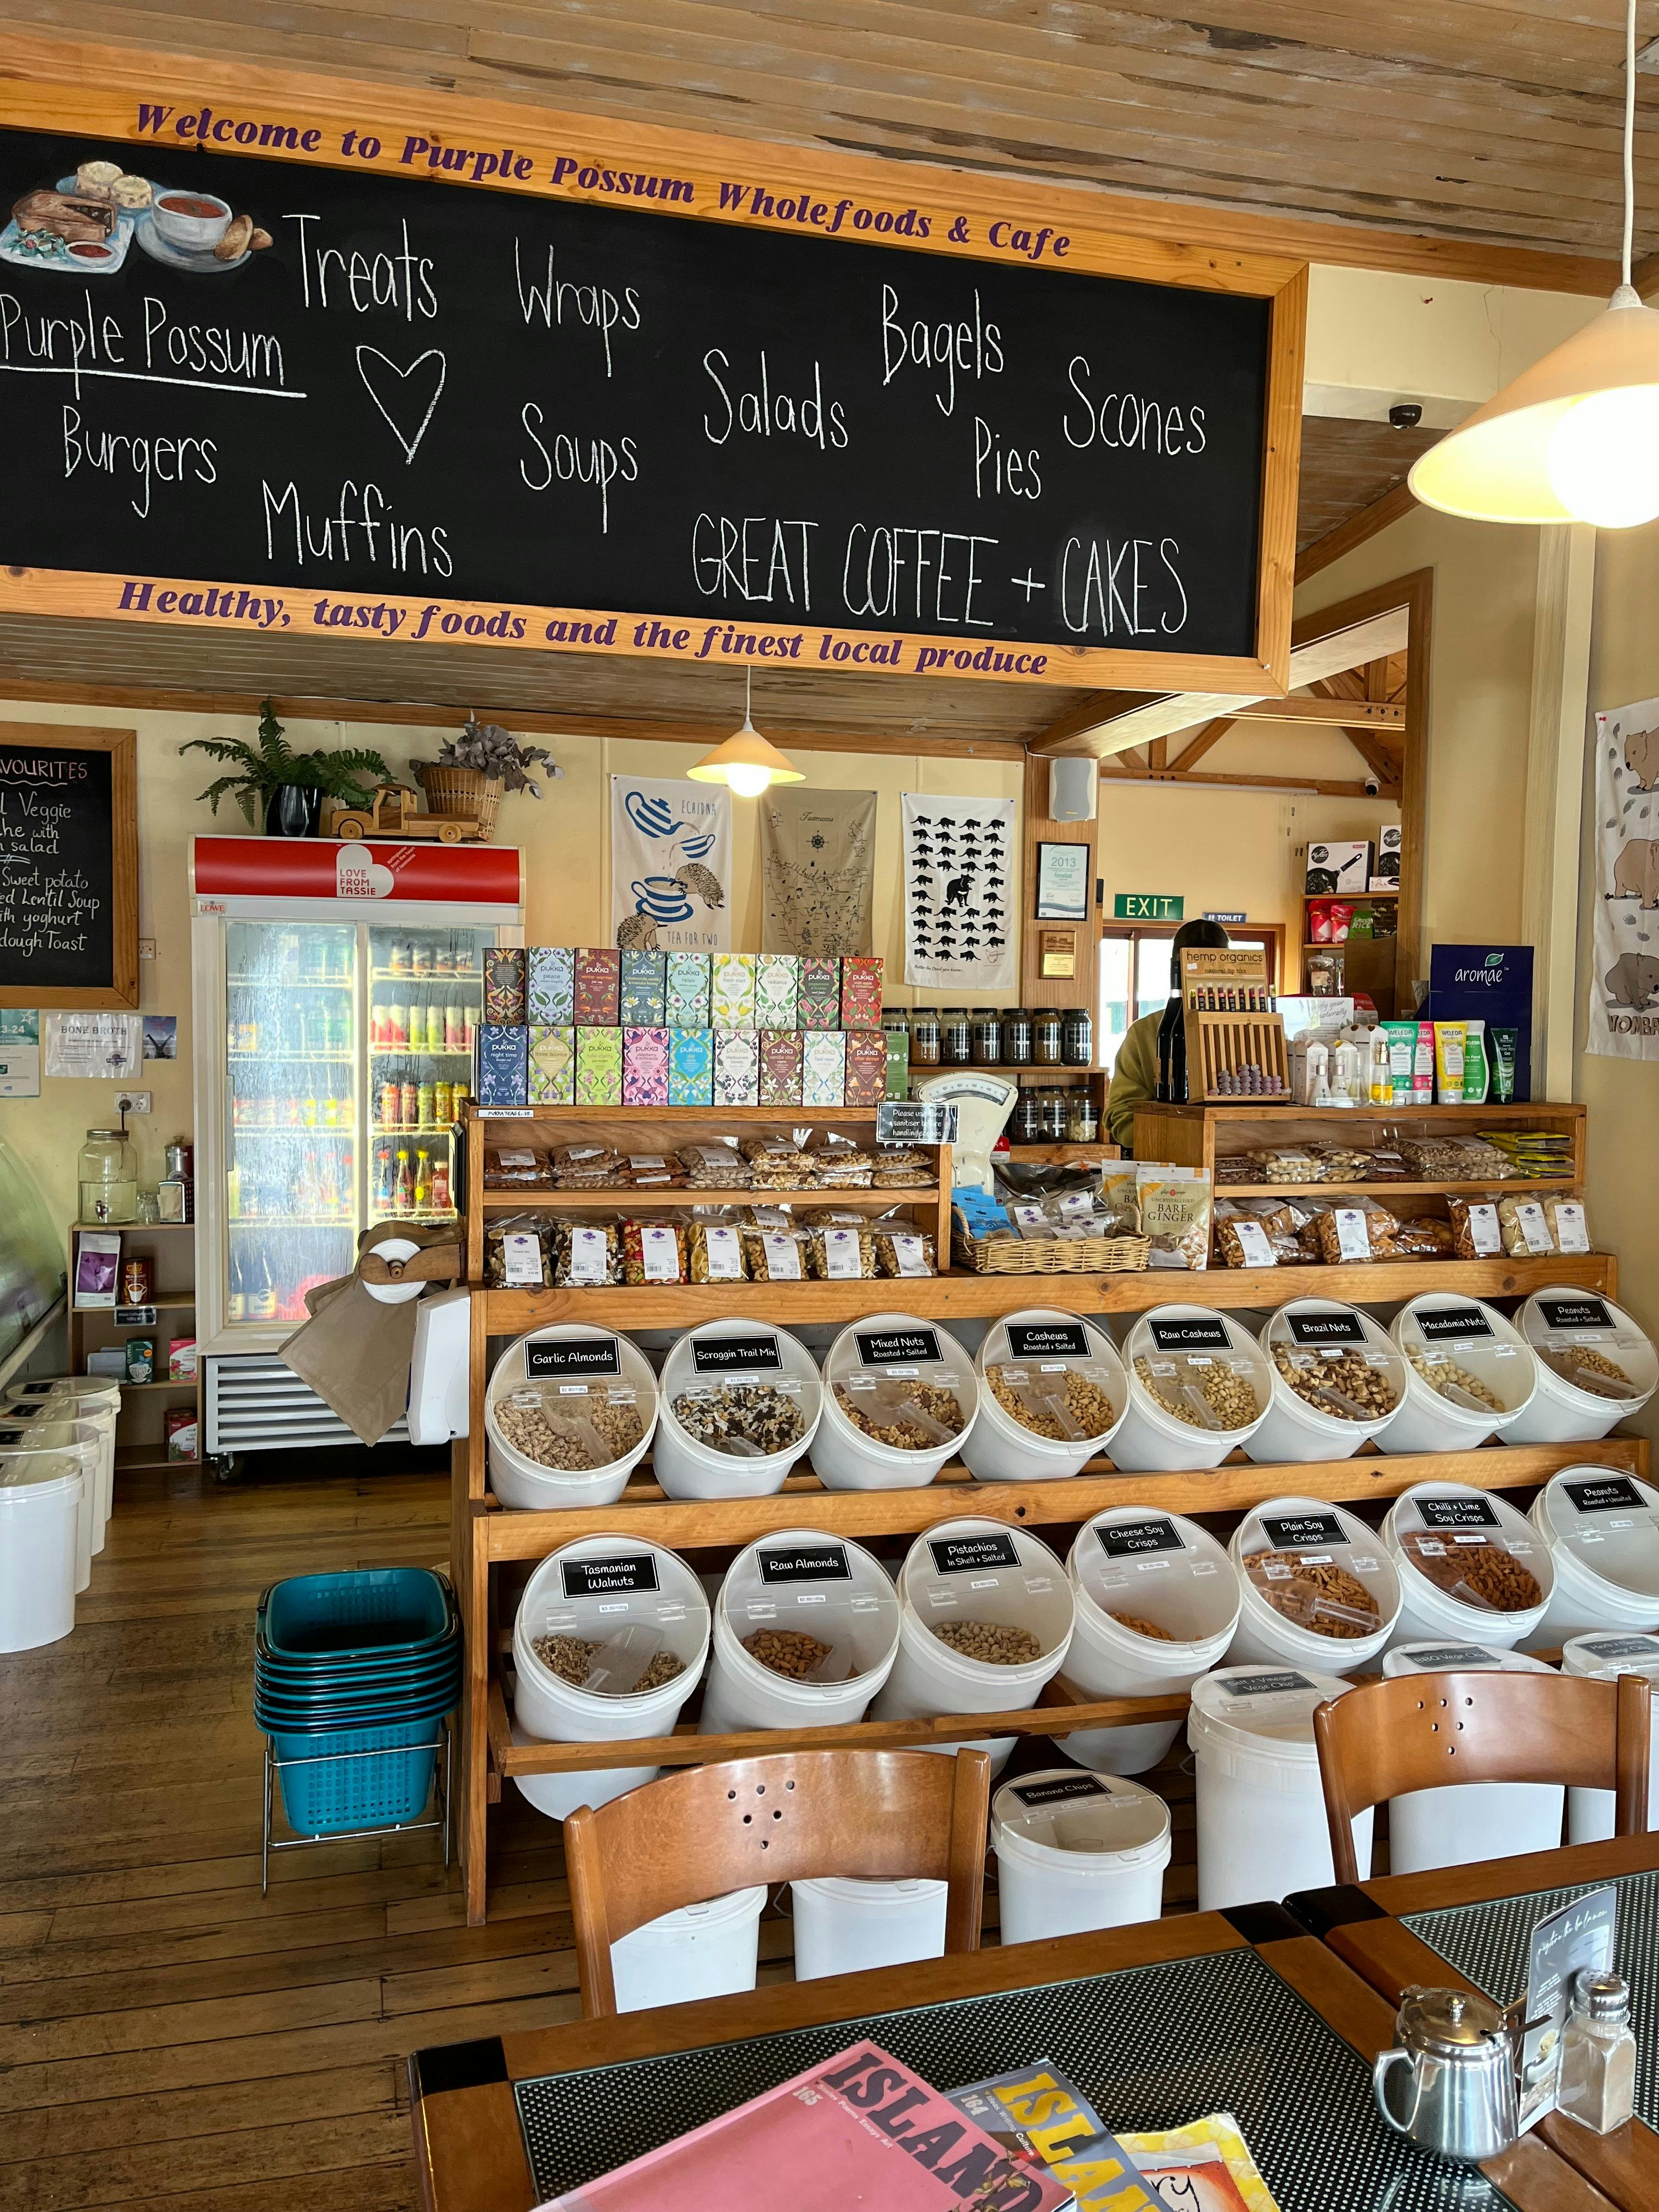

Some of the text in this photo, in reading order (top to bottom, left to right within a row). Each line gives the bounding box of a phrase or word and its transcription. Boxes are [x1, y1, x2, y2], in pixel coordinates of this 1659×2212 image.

[137, 104, 1071, 259] Welcome to Purple Possum Wholefoods & Cafe
[281, 214, 437, 321] Treats
[516, 236, 641, 377] Wraps
[0, 289, 284, 399] Purple Possum
[882, 284, 1004, 416] Bagels
[703, 349, 849, 449] Salads
[1064, 356, 1206, 455] Scones
[63, 405, 217, 518] Burgers
[975, 416, 1041, 499] Pies
[520, 403, 638, 534] Soups
[262, 480, 453, 577] Muffins
[692, 514, 1188, 637] GREAT COFFEE + CAKES
[117, 581, 1048, 675] Healthy, tasty foods and the finest local produce
[18, 791, 71, 825] Veggie
[799, 811, 834, 822] Tasmania
[32, 823, 60, 839] with
[12, 837, 59, 854] salad
[1051, 857, 1076, 867] 2013
[340, 868, 366, 878] LOVE
[2, 866, 89, 897] Sweet potato
[340, 878, 369, 887] FROM
[340, 887, 376, 895] TASSIE
[22, 888, 100, 919] Lentil Soup
[1126, 896, 1173, 917] EXIT
[22, 907, 83, 933] yoghurt
[1217, 914, 1243, 922] TOILET
[45, 930, 88, 951] Toast
[667, 932, 718, 946] TEA FOR TWO
[1186, 951, 1263, 963] hemp organics
[1455, 969, 1503, 986] aromae
[61, 1025, 127, 1035] BONE BROTH
[1607, 1014, 1659, 1036] WOMBA
[893, 1119, 920, 1127] sanitiser
[893, 1128, 919, 1138] handling
[1158, 1204, 1187, 1213] BARE
[1148, 1212, 1194, 1222] GINGER
[1558, 1306, 1590, 1315] Peanuts
[1302, 1323, 1351, 1333] Brazil Nuts
[1421, 1317, 1486, 1331] Macadamia Nuts
[1026, 1331, 1068, 1341] Cashews
[1160, 1329, 1221, 1339] Raw Cashews
[871, 1336, 924, 1348] Mixed Nuts
[1023, 1343, 1049, 1351] Roasted
[533, 1350, 613, 1365] Garlic Almonds
[697, 1347, 776, 1361] Scroggin Trail Mix
[873, 1348, 928, 1358] Roasted Salted
[1584, 1487, 1619, 1497] Peanuts
[1427, 1501, 1481, 1512] Chilli Lime
[1280, 1519, 1324, 1532] Plain Soy
[1435, 1513, 1484, 1524] Soy Crisps
[1110, 1525, 1165, 1539] Cheese Soy
[1293, 1533, 1323, 1543] Crisps
[948, 1542, 997, 1555] Pistachios
[1127, 1538, 1158, 1549] Crisps
[770, 1557, 839, 1571] Raw Almonds
[956, 1552, 1006, 1566] Shell Salted
[580, 1562, 636, 1576] Tasmanian
[588, 1576, 634, 1589] Walnuts
[1414, 1652, 1464, 1664] BBQ Vege
[1256, 1675, 1294, 1683] Vinegar
[1026, 1783, 1094, 1798] Banana Chips
[791, 2086, 823, 2106] 165
[960, 2094, 989, 2116] 164
[817, 2083, 894, 2150] Stories Poems Essays Art
